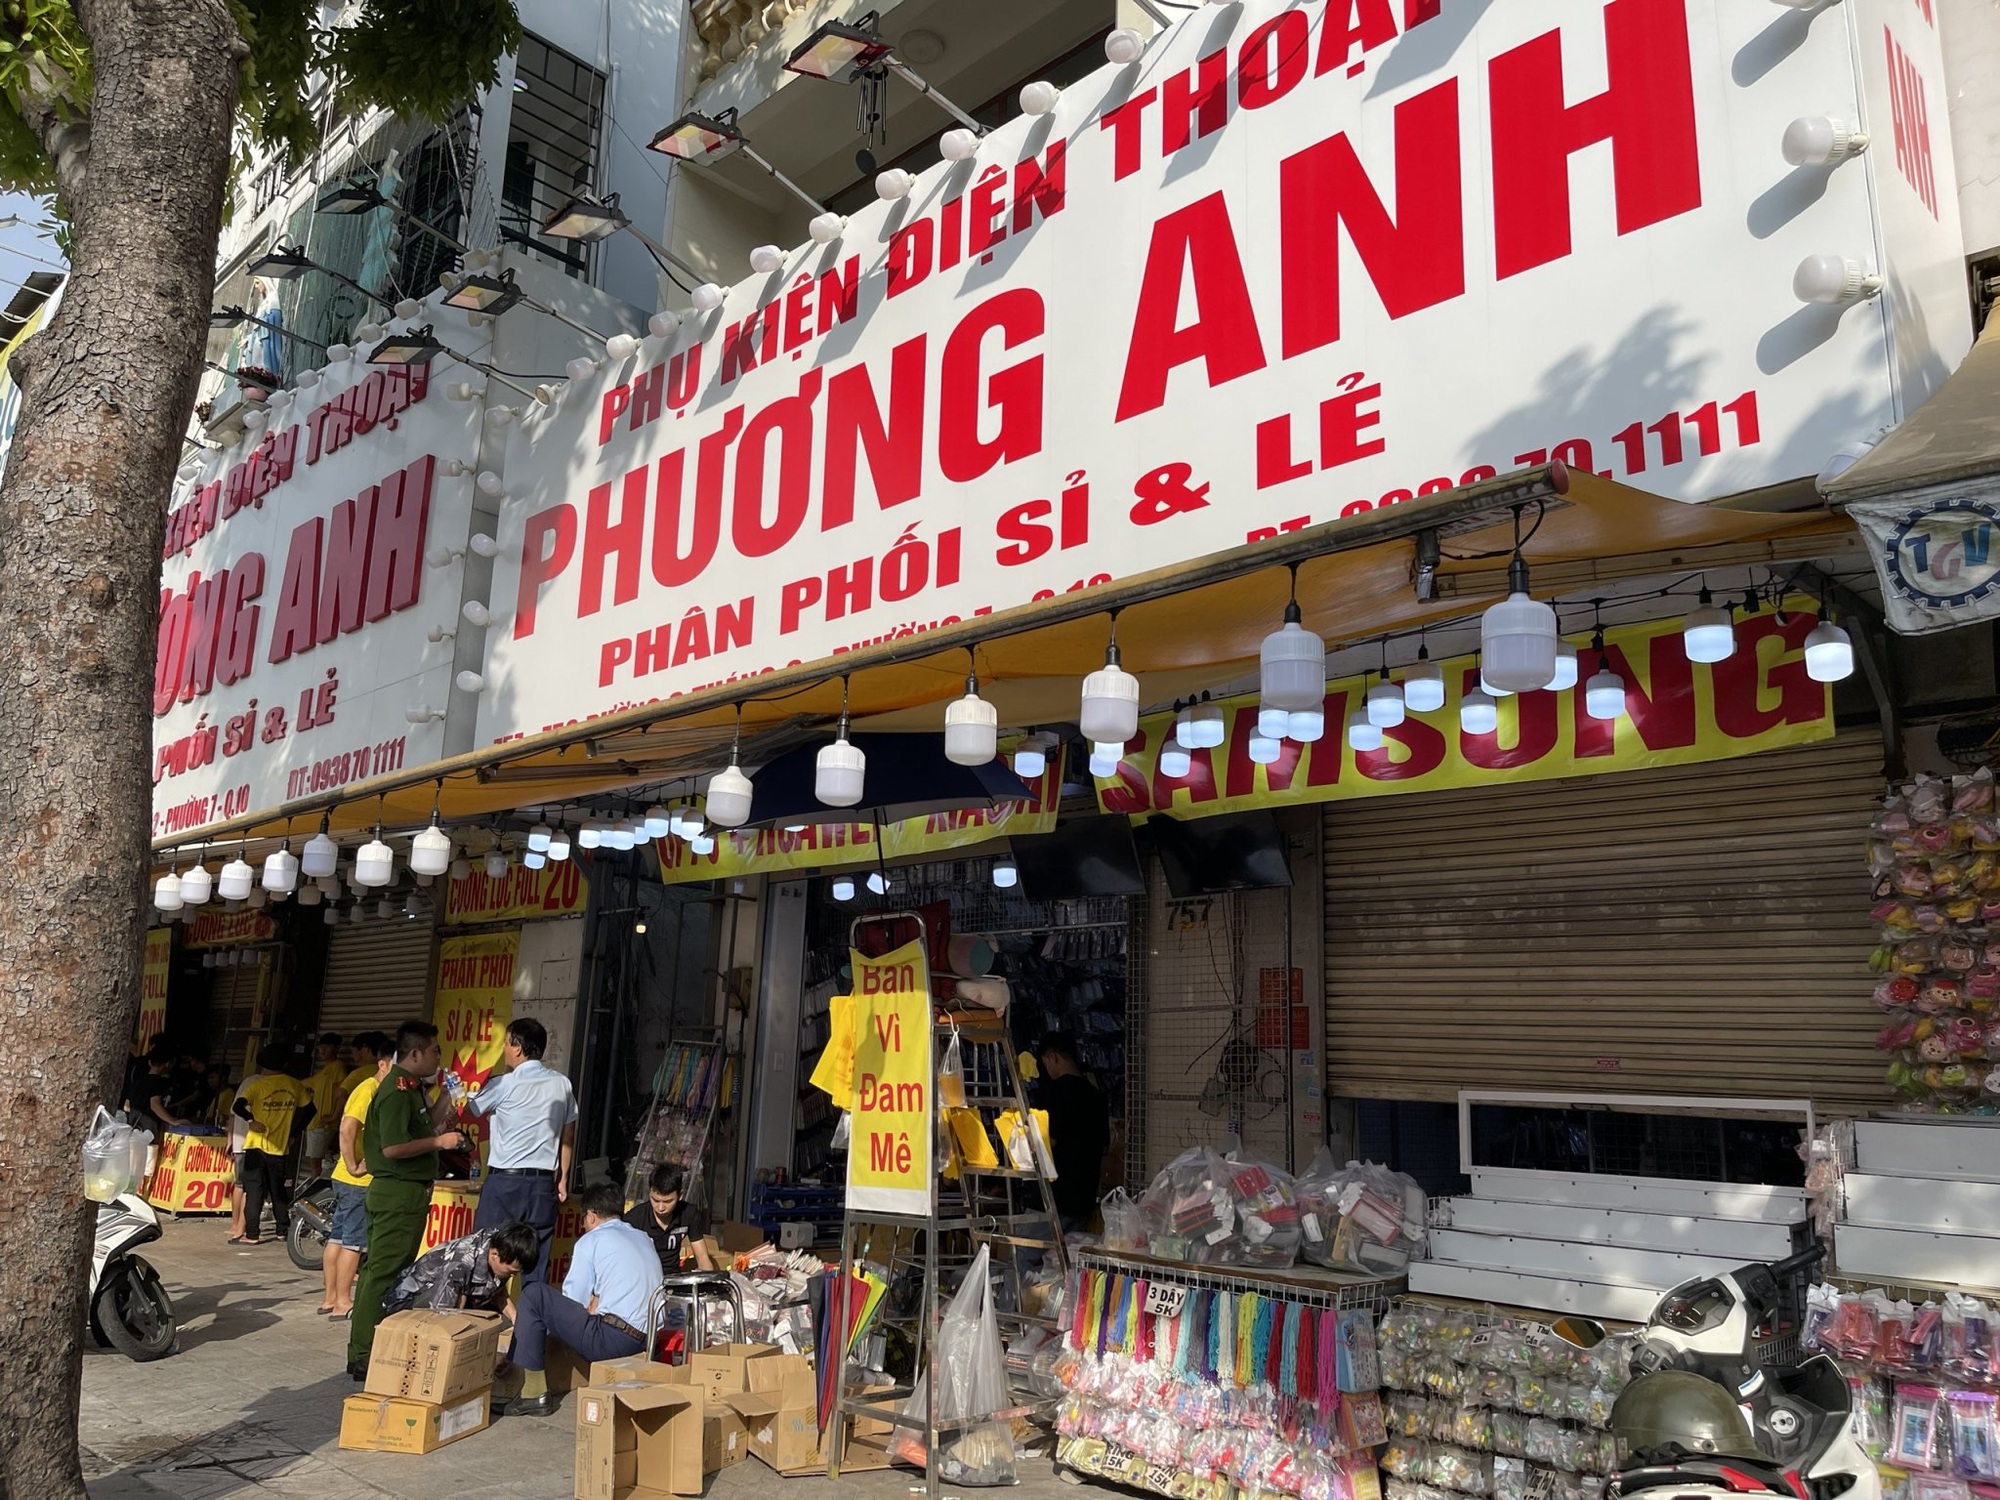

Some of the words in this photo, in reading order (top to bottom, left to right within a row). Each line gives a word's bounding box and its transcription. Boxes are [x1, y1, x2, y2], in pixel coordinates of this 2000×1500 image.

[599, 343, 702, 447] PHỤ
[720, 253, 860, 386] KIỆN
[887, 137, 1066, 300] ĐIỆN
[513, 287, 1045, 641] PHƯƠNG
[1114, 0, 1702, 423] ANH
[222, 424, 299, 520] ĐIỆN
[306, 361, 431, 467] THOẠI
[599, 606, 755, 687] PHÂN
[780, 521, 962, 636] PHỐI
[997, 469, 1090, 567] SỈ
[1129, 462, 1211, 527] &
[1256, 371, 1385, 490] LẺ
[268, 454, 435, 665] ANH
[222, 698, 258, 758] SỈ
[262, 706, 288, 743] &
[296, 667, 339, 733] LẺ
[1101, 610, 1827, 814] SAMSUNG
[209, 793, 219, 823] 7
[441, 945, 478, 989] PHÂN
[479, 943, 514, 988] PHỐI
[463, 1012, 473, 1042] &
[875, 1011, 901, 1052] Vì
[859, 1072, 923, 1113] Đam
[870, 1131, 912, 1174] Mê
[1149, 1287, 1158, 1300] 3
[1160, 1288, 1184, 1306] DÂY
[1154, 1304, 1174, 1316] 5K
[1148, 1469, 1171, 1490] 15K
